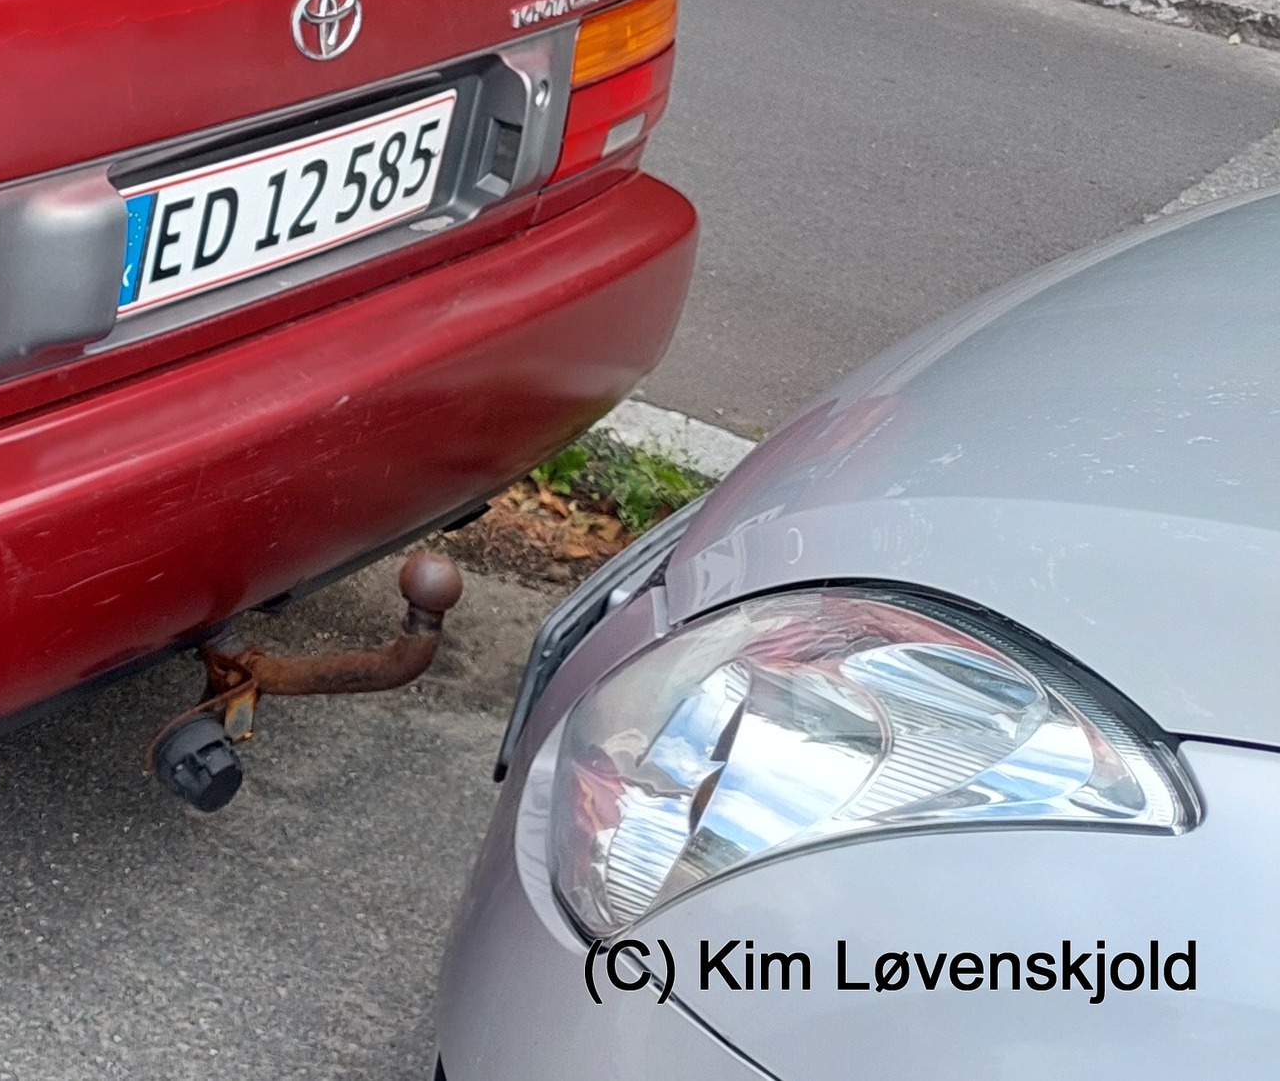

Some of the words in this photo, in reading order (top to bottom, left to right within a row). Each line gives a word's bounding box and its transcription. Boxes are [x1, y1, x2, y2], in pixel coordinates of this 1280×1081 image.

[149, 186, 240, 284] ED
[254, 158, 328, 252] 12
[334, 118, 441, 225] 585
